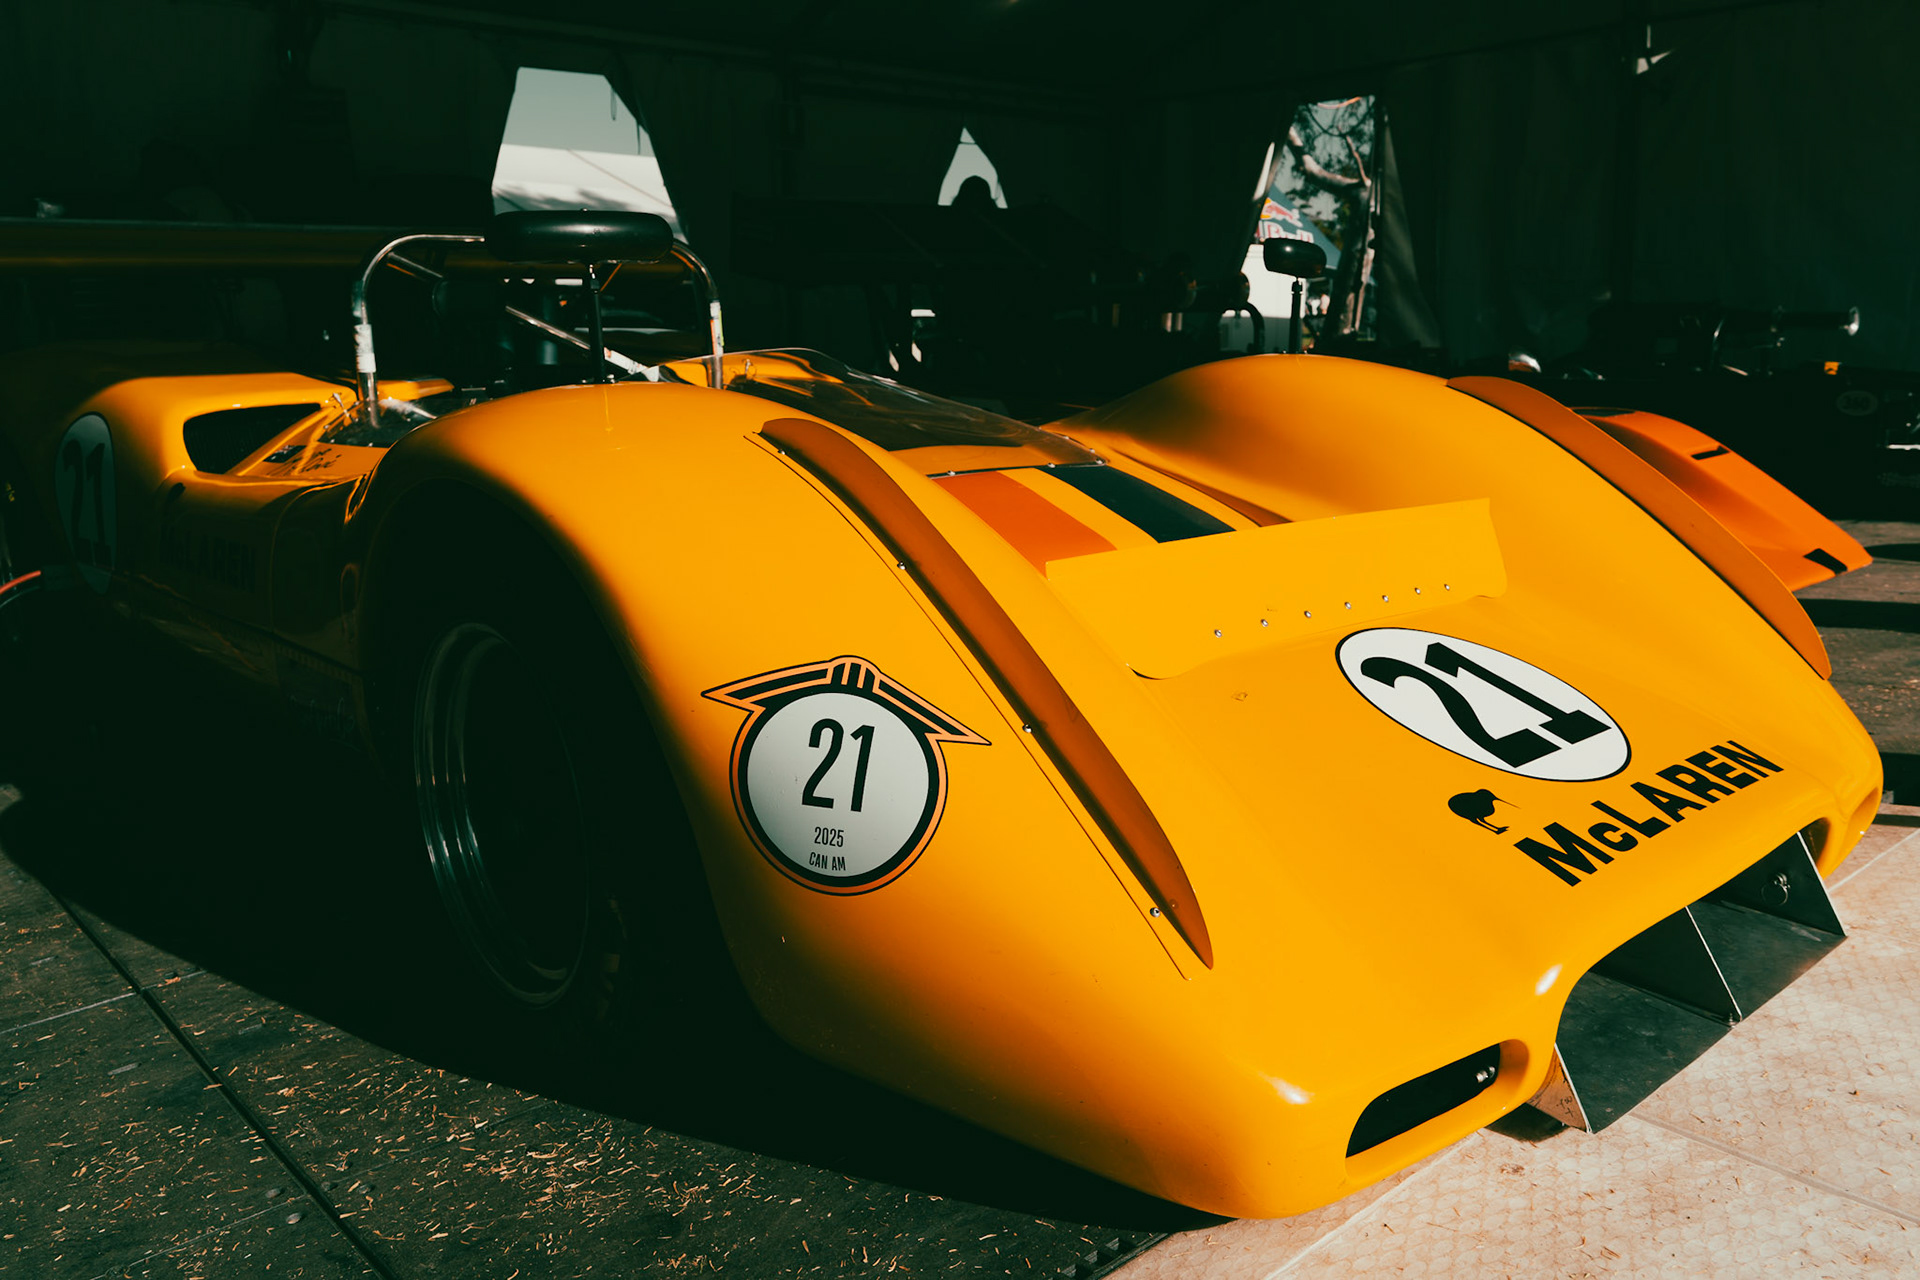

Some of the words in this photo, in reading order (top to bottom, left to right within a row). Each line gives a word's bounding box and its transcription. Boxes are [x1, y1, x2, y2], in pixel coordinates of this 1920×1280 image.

[62, 438, 114, 569] 21
[1360, 641, 1612, 768] 21
[801, 718, 875, 812] 21
[1513, 740, 1784, 887] McLAREN
[809, 852, 828, 870] CAN
[831, 854, 846, 871] AM
[814, 826, 844, 847] 2025
